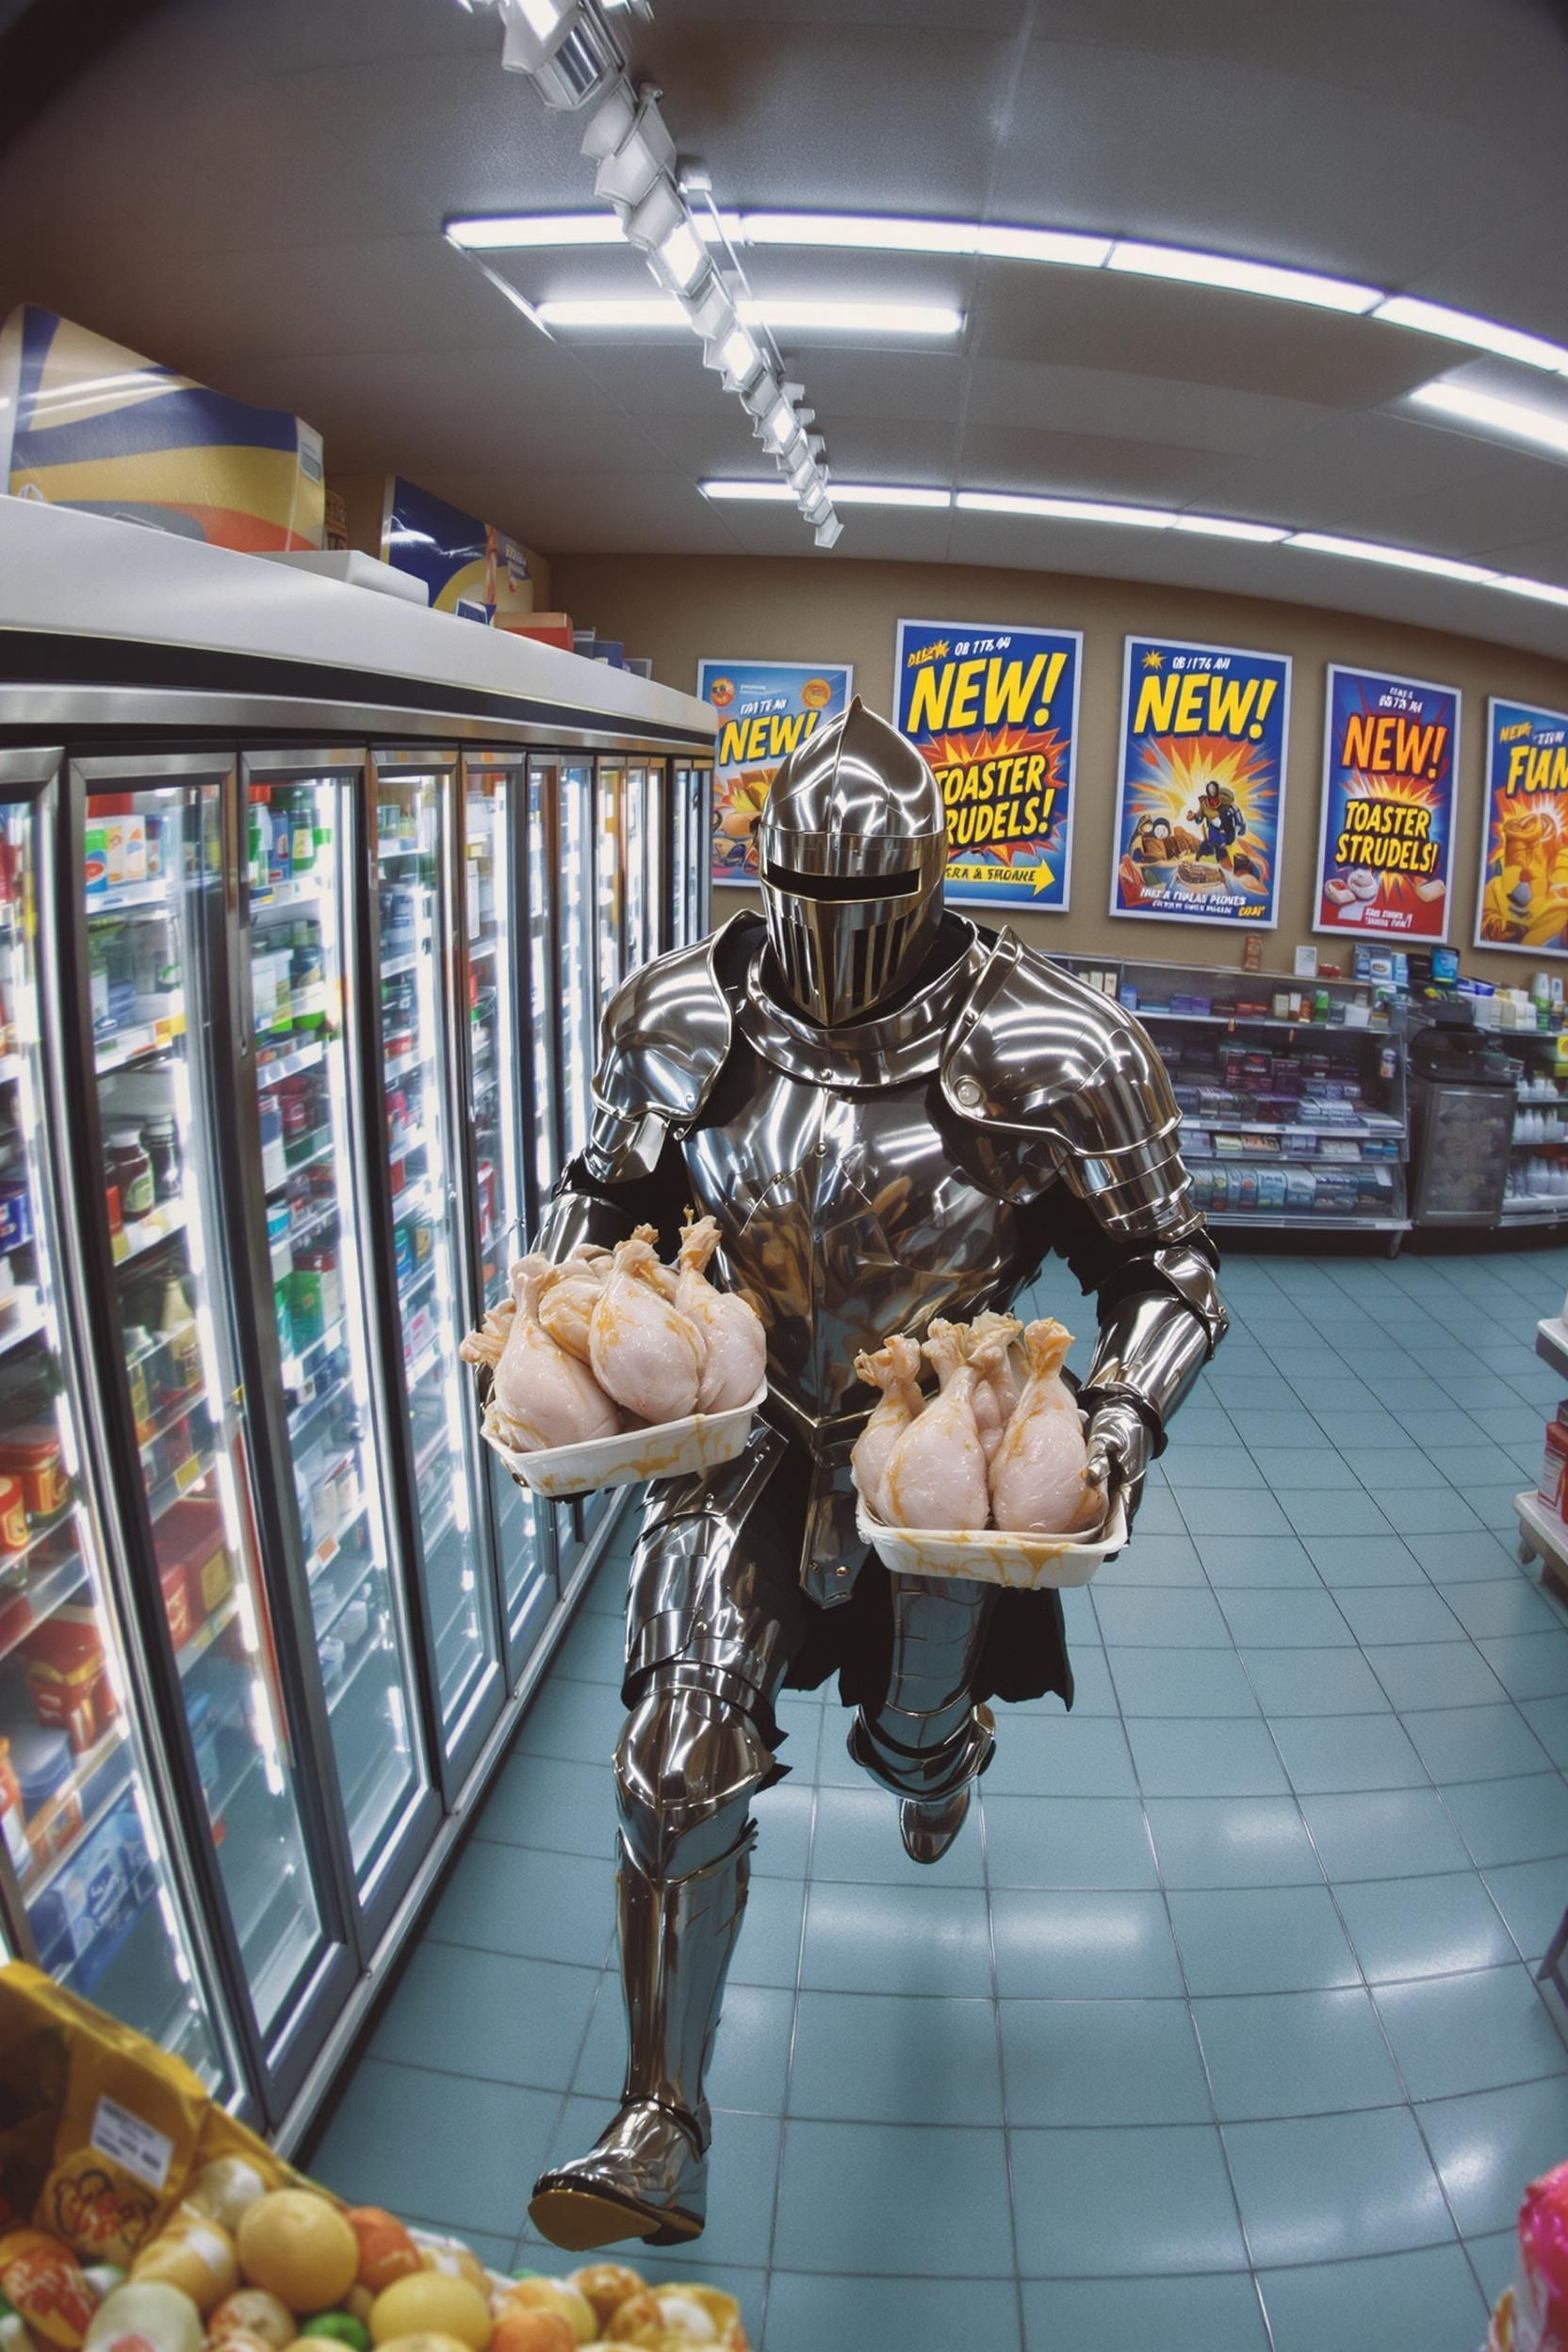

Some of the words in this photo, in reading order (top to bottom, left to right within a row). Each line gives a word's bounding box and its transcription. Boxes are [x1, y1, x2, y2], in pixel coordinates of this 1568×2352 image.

[906, 652, 1068, 733] NEW!
[1133, 673, 1279, 739] NEW!
[1342, 715, 1447, 778] NEW!
[935, 754, 1046, 806] TOASTER
[945, 789, 1054, 845] RUDELS!
[1345, 801, 1431, 839] TOASTER
[1335, 833, 1438, 874] STRUDELS!
